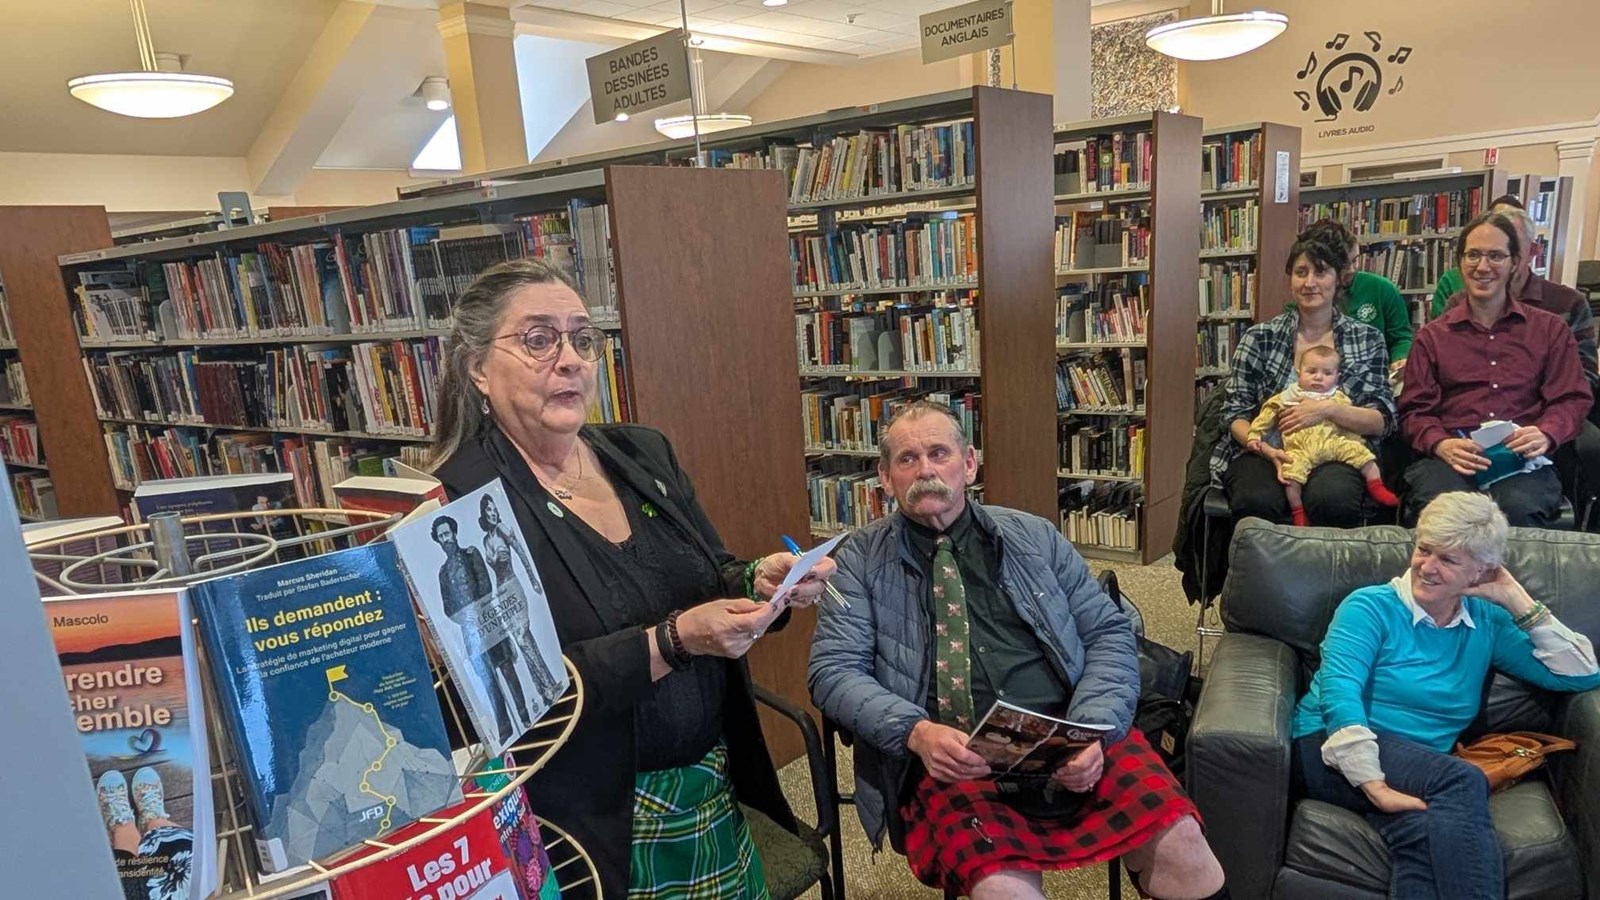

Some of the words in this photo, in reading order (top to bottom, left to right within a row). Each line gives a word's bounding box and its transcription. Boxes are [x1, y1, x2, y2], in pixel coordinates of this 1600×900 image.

[924, 8, 1004, 37] DOCUMENTAIRES
[941, 26, 989, 46] ANGLAIS
[609, 46, 659, 74] BANDES
[604, 63, 670, 95] DESSINÉES
[613, 84, 667, 112] ADULTES
[1318, 128, 1348, 138] LIVRES
[1348, 125, 1375, 135] AUDIO
[255, 589, 283, 602] Traduit
[283, 587, 296, 597] par
[296, 581, 320, 593] Stefan
[277, 576, 305, 587] Marcus
[305, 568, 338, 581] Sheridan
[53, 613, 109, 628] Mascolo
[245, 616, 270, 633] Ils
[273, 590, 373, 627] demandent
[477, 593, 517, 626] LÉGENDES
[254, 631, 300, 652] vous
[303, 608, 384, 640] répondez
[236, 664, 248, 675] La
[286, 652, 298, 661] de
[298, 641, 338, 657] marketing
[338, 633, 363, 647] digital
[363, 630, 380, 641] pour
[381, 623, 406, 636] gagner
[269, 660, 309, 676] confiance
[310, 656, 321, 665] de
[321, 646, 358, 661] l'acheteur
[359, 636, 392, 651] moderne
[359, 805, 384, 823] JFD
[127, 855, 169, 866] résilience
[407, 852, 456, 892] Les
[453, 835, 469, 866] 7
[436, 857, 491, 900] pour
